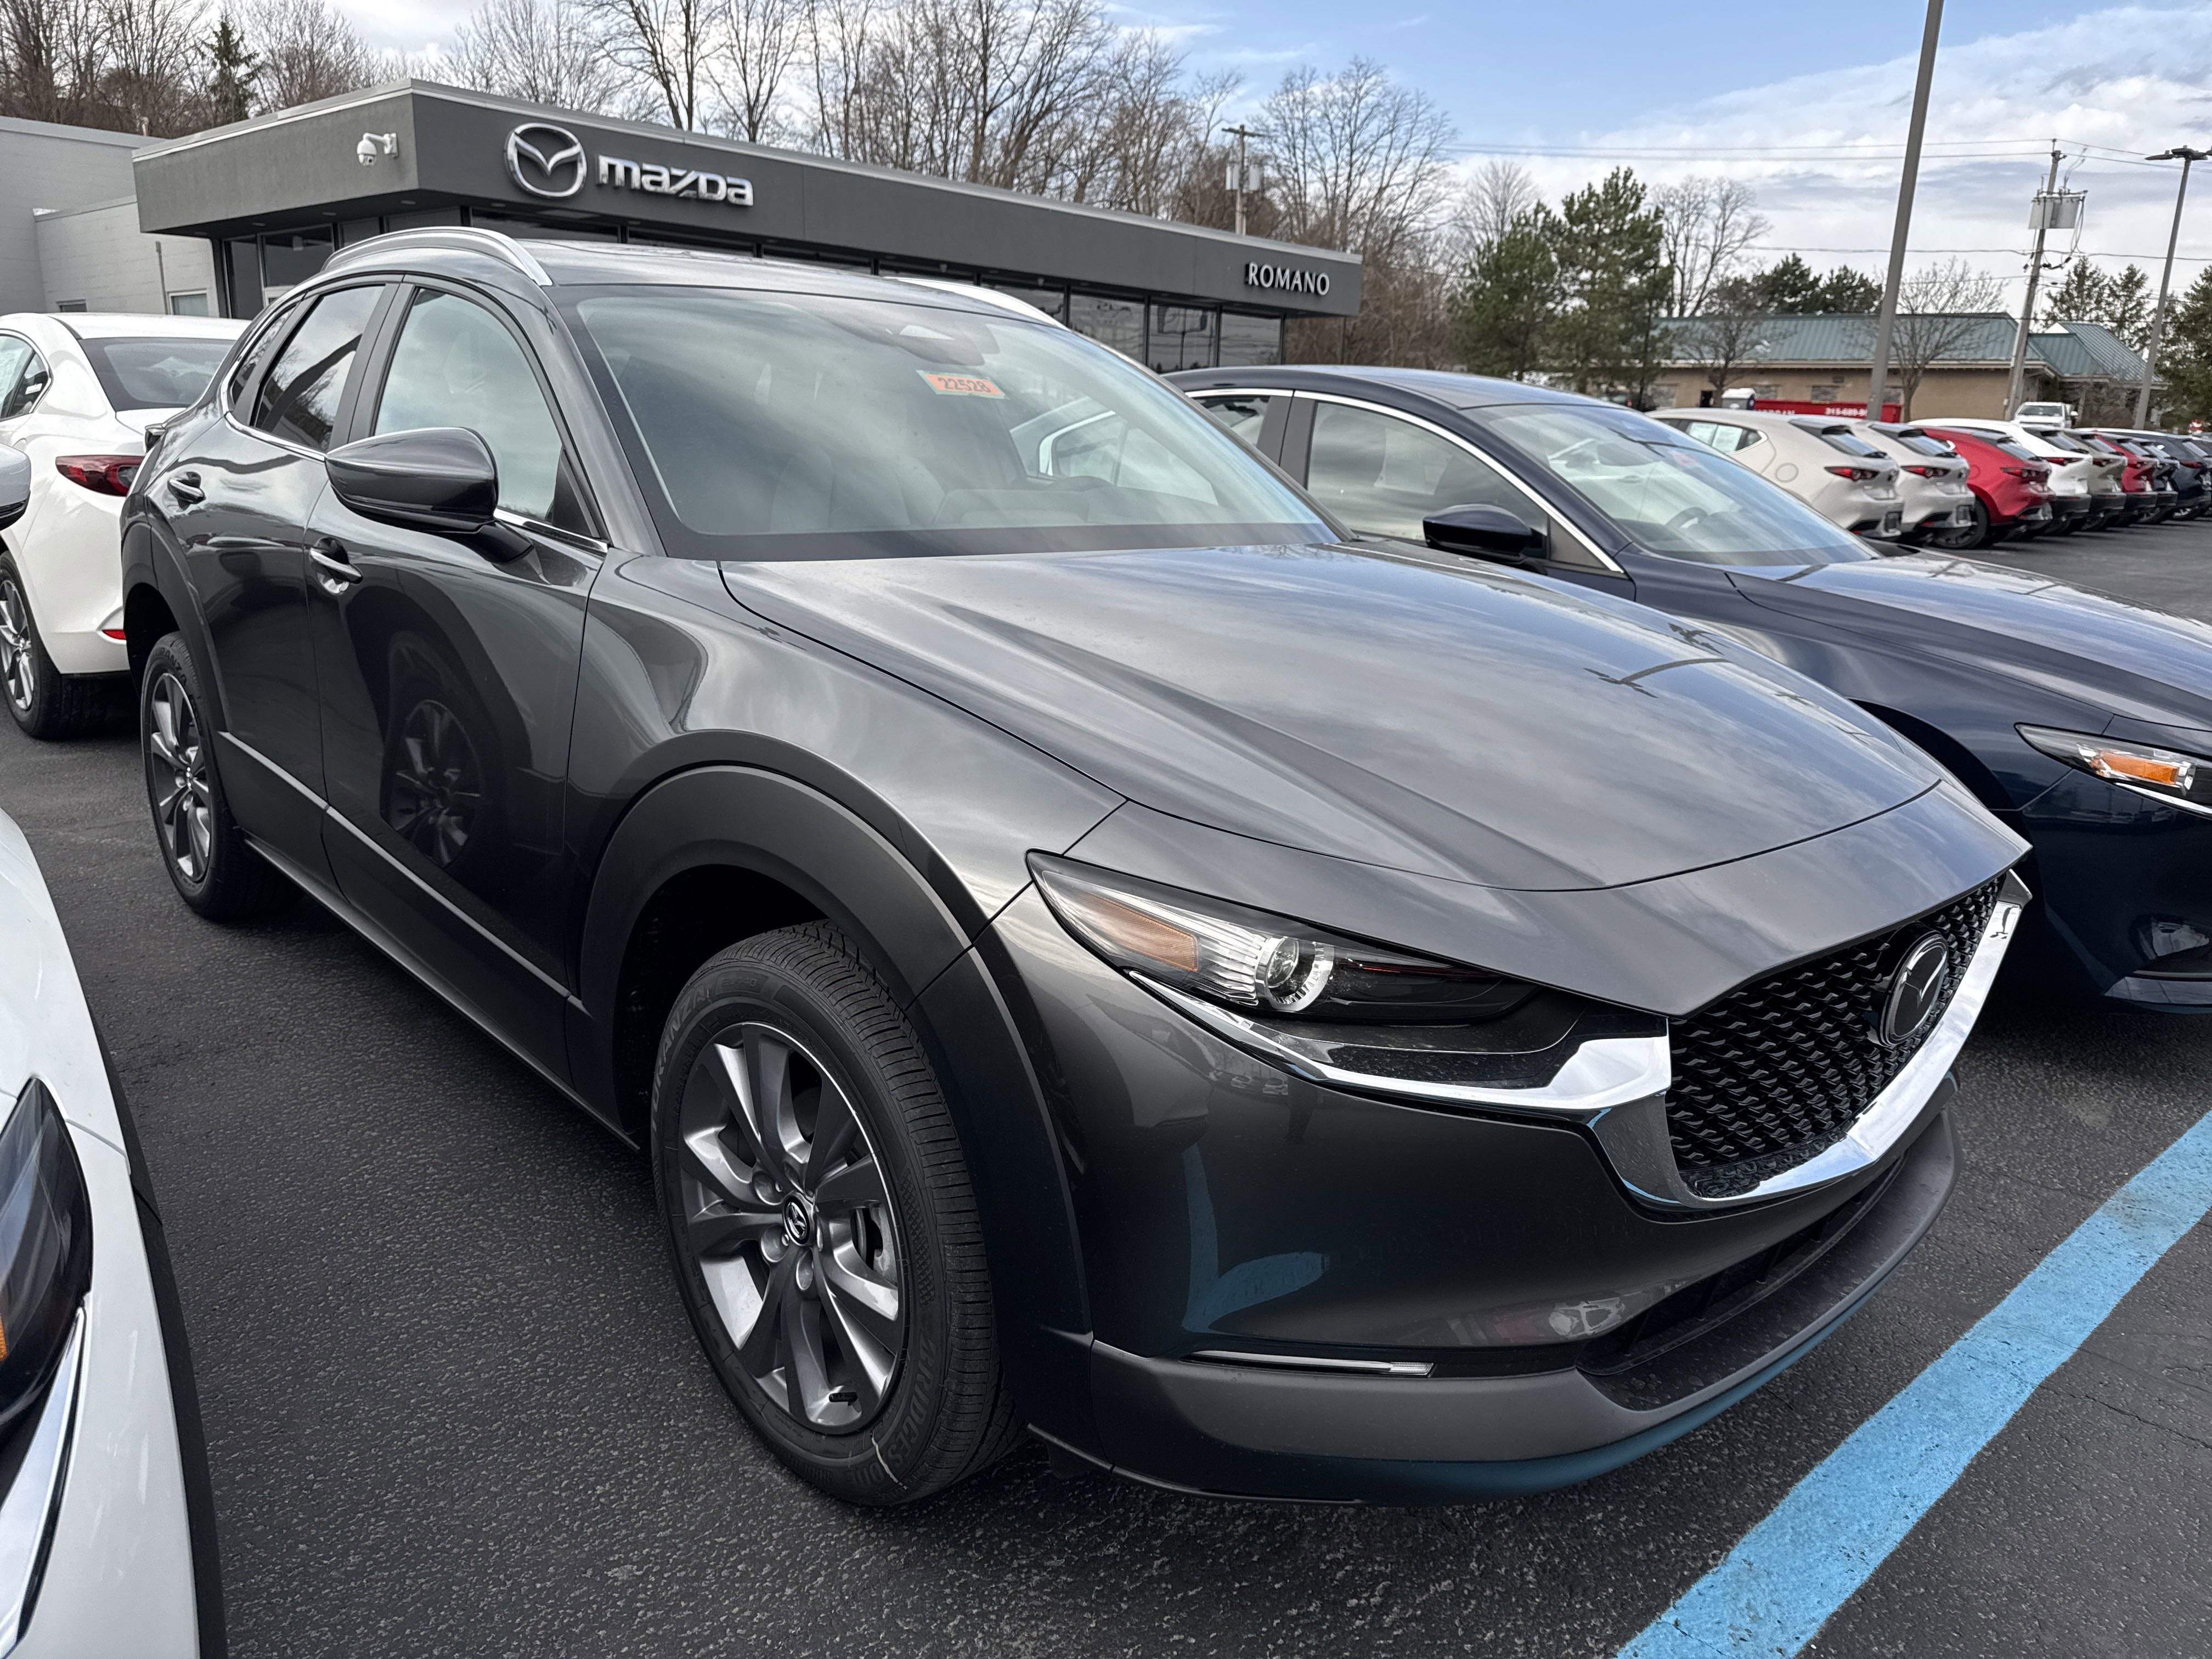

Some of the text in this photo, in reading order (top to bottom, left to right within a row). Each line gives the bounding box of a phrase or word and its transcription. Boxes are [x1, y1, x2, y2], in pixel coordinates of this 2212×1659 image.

[596, 154, 753, 206] mazda
[1248, 261, 1330, 295] ROMANO
[938, 377, 991, 393] 22528
